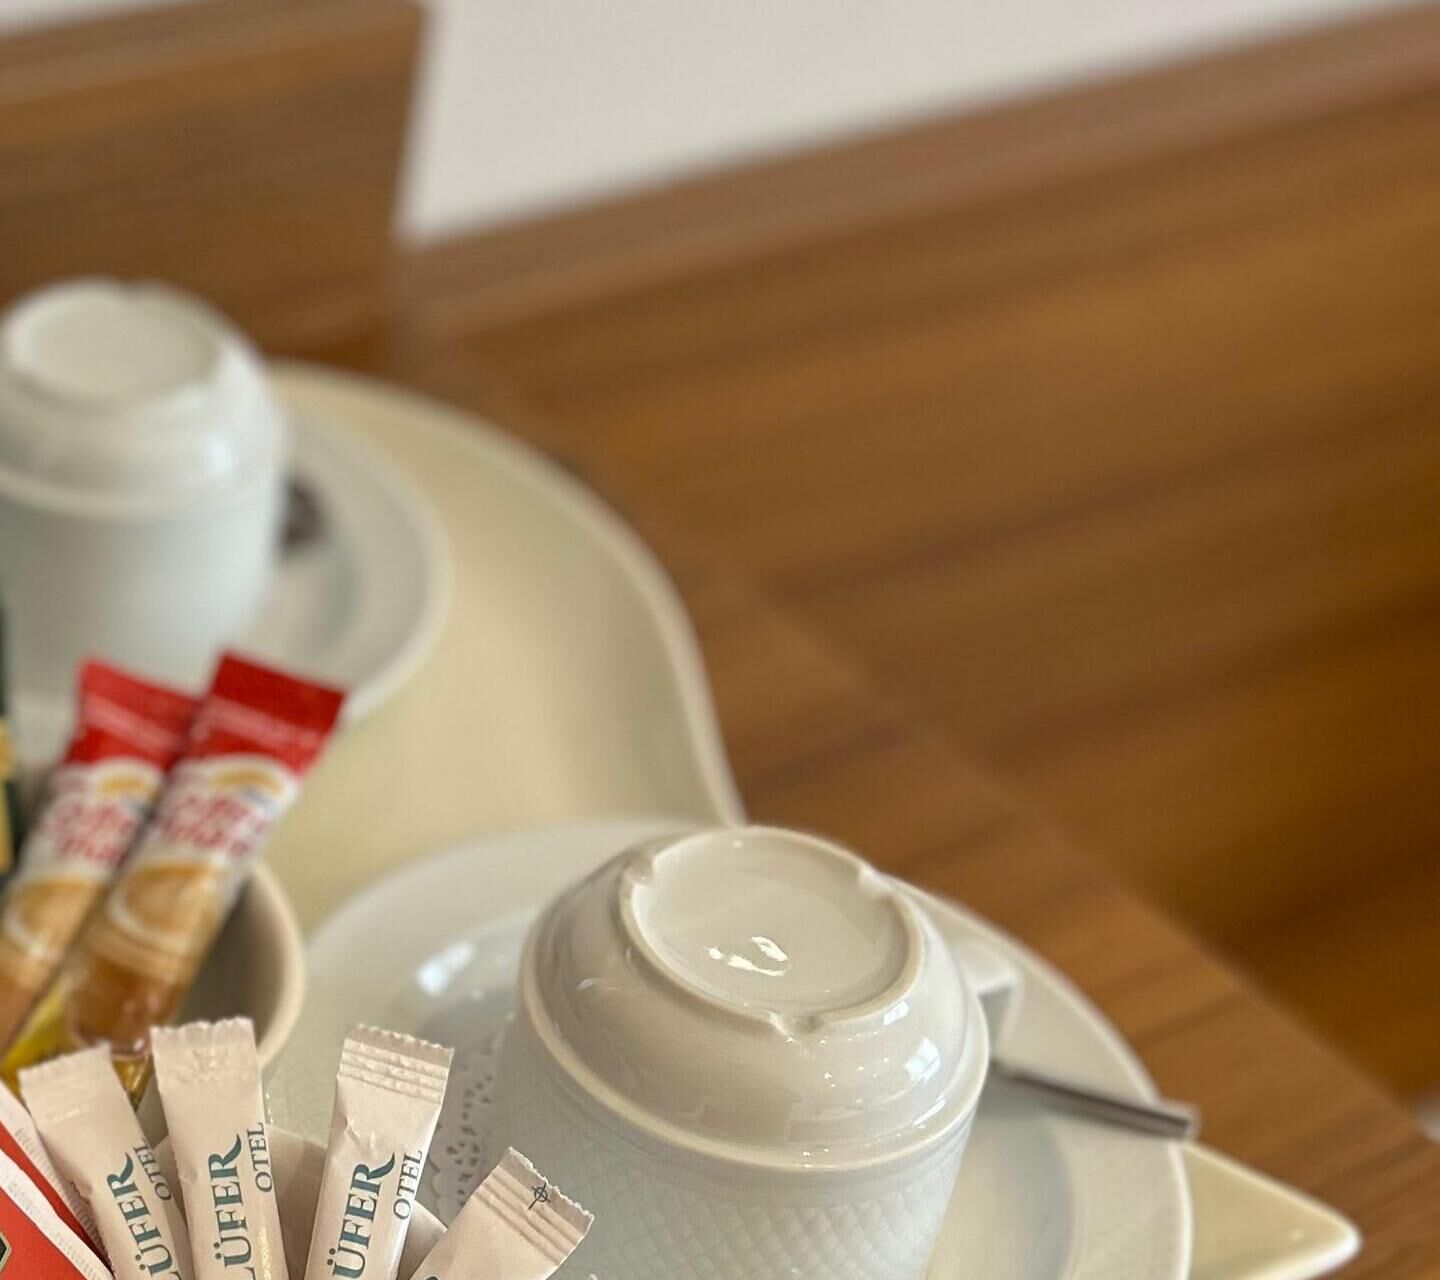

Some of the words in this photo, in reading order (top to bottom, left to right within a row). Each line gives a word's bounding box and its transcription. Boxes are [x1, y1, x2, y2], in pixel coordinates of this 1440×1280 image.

[133, 1144, 173, 1202] OTEL
[245, 1121, 273, 1193] OTEL
[392, 1150, 424, 1221] OTEL
